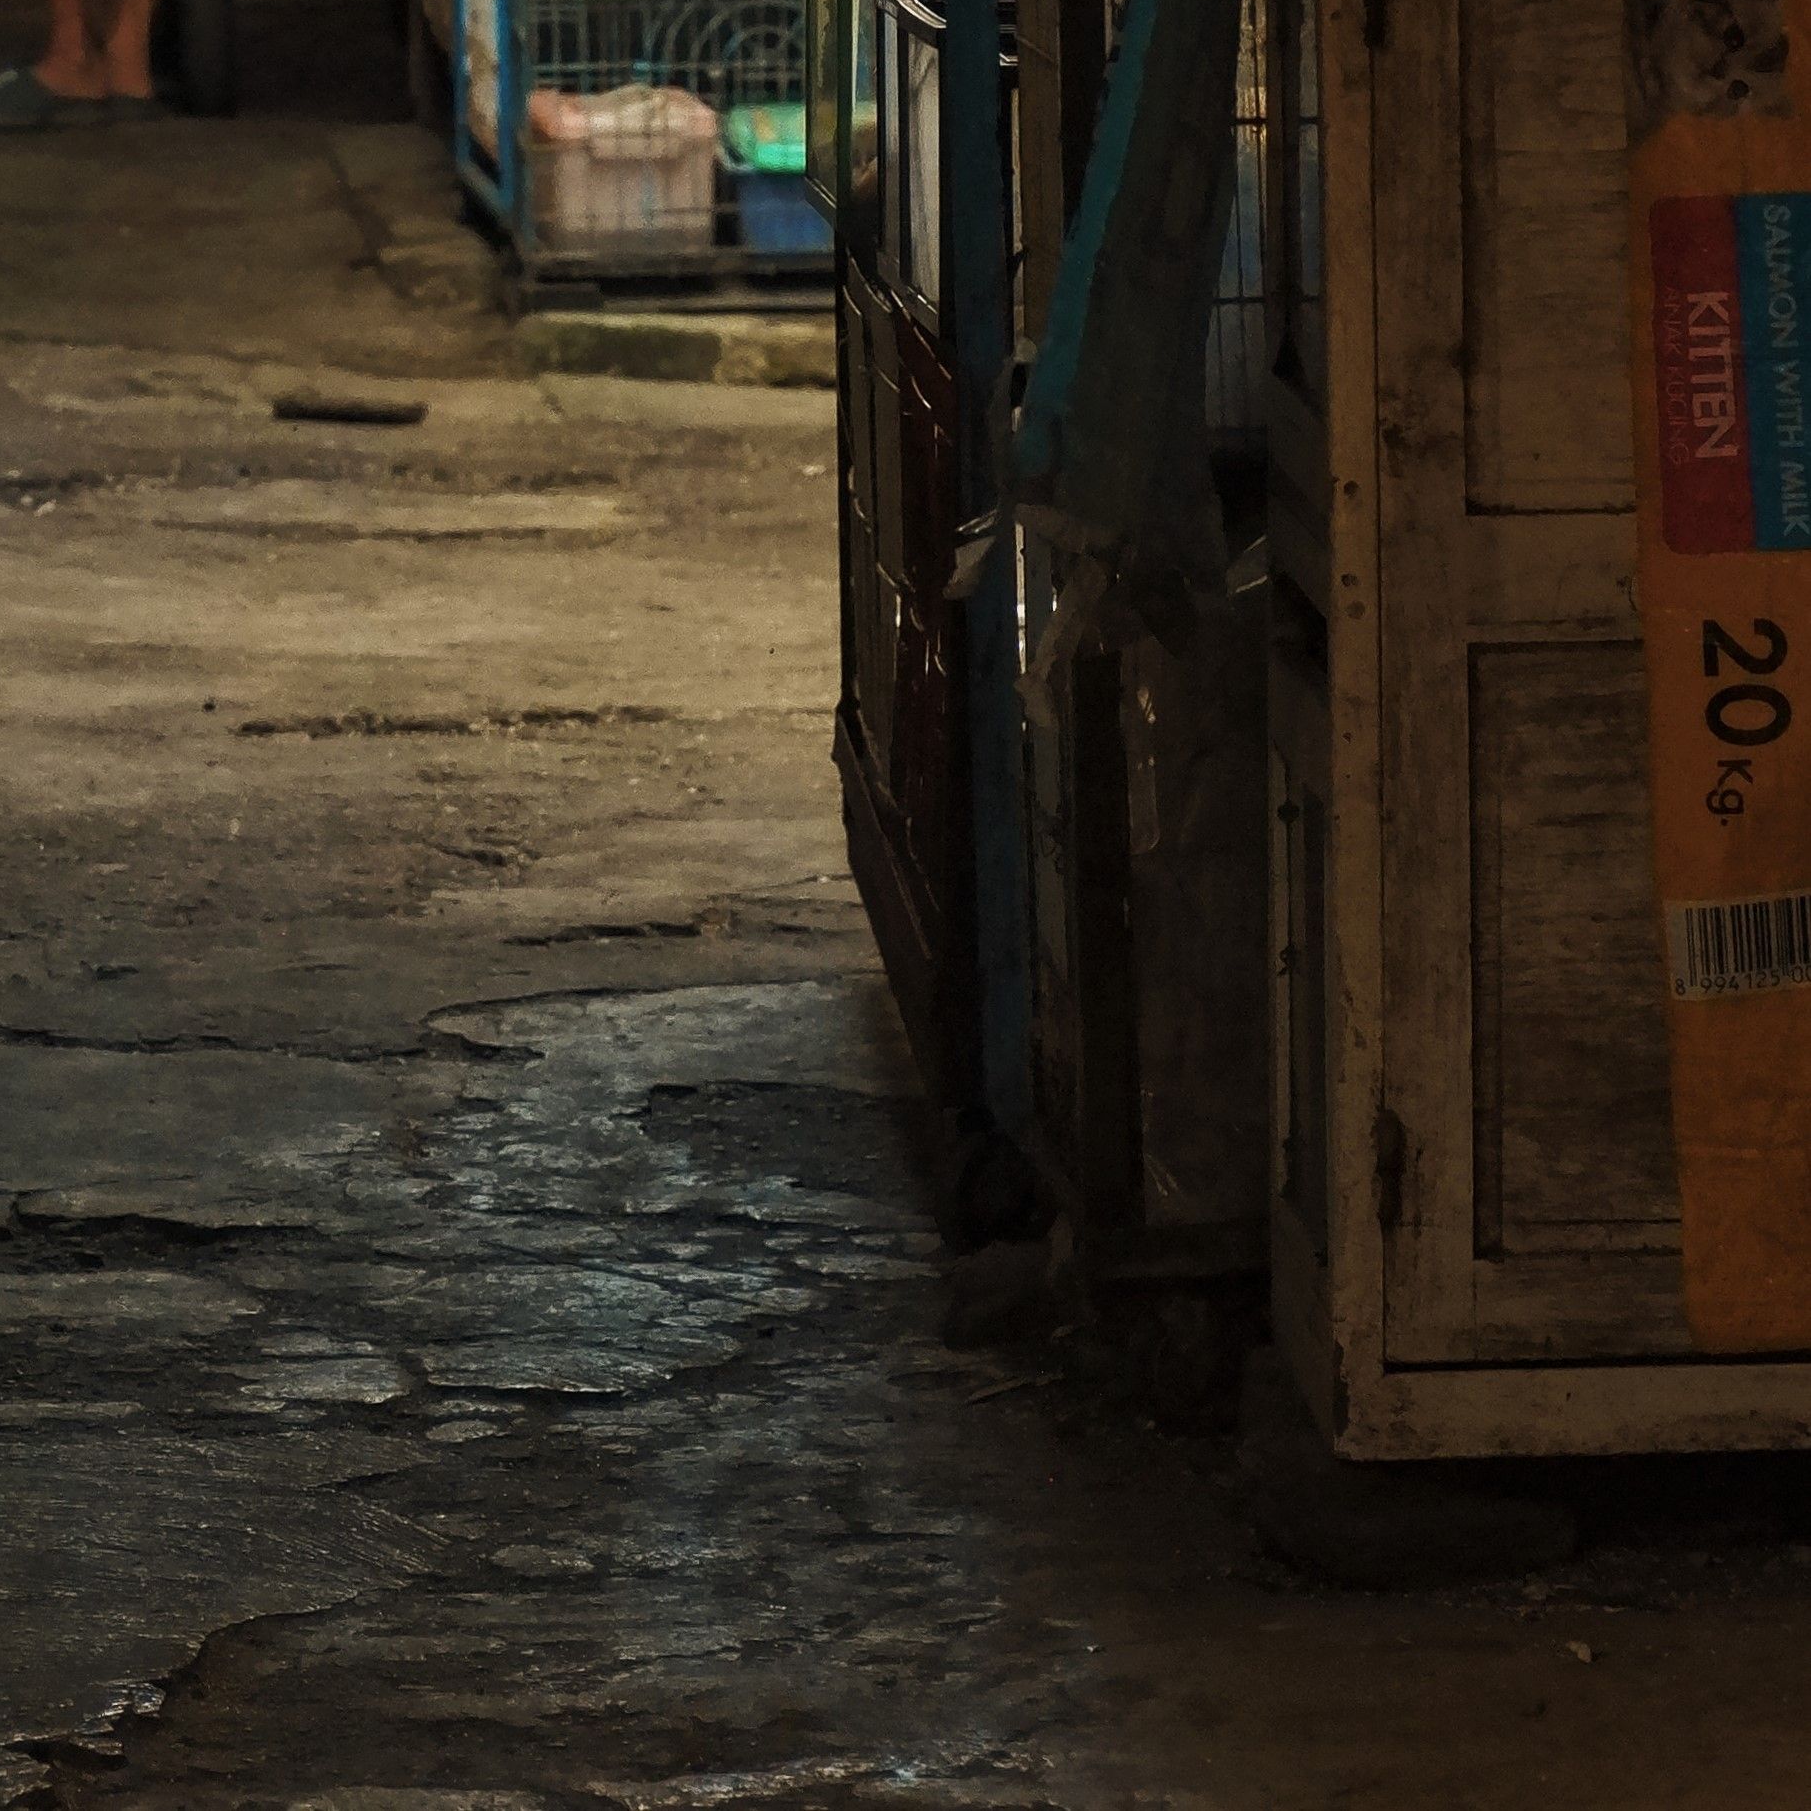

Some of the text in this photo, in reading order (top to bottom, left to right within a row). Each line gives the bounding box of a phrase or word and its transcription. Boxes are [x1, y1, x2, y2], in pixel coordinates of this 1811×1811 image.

[1662, 285, 1682, 356] ANAK
[1688, 290, 1739, 459] KITTEN
[1763, 203, 1810, 537] SALMON WITH MILK
[1703, 617, 1792, 747] 20
